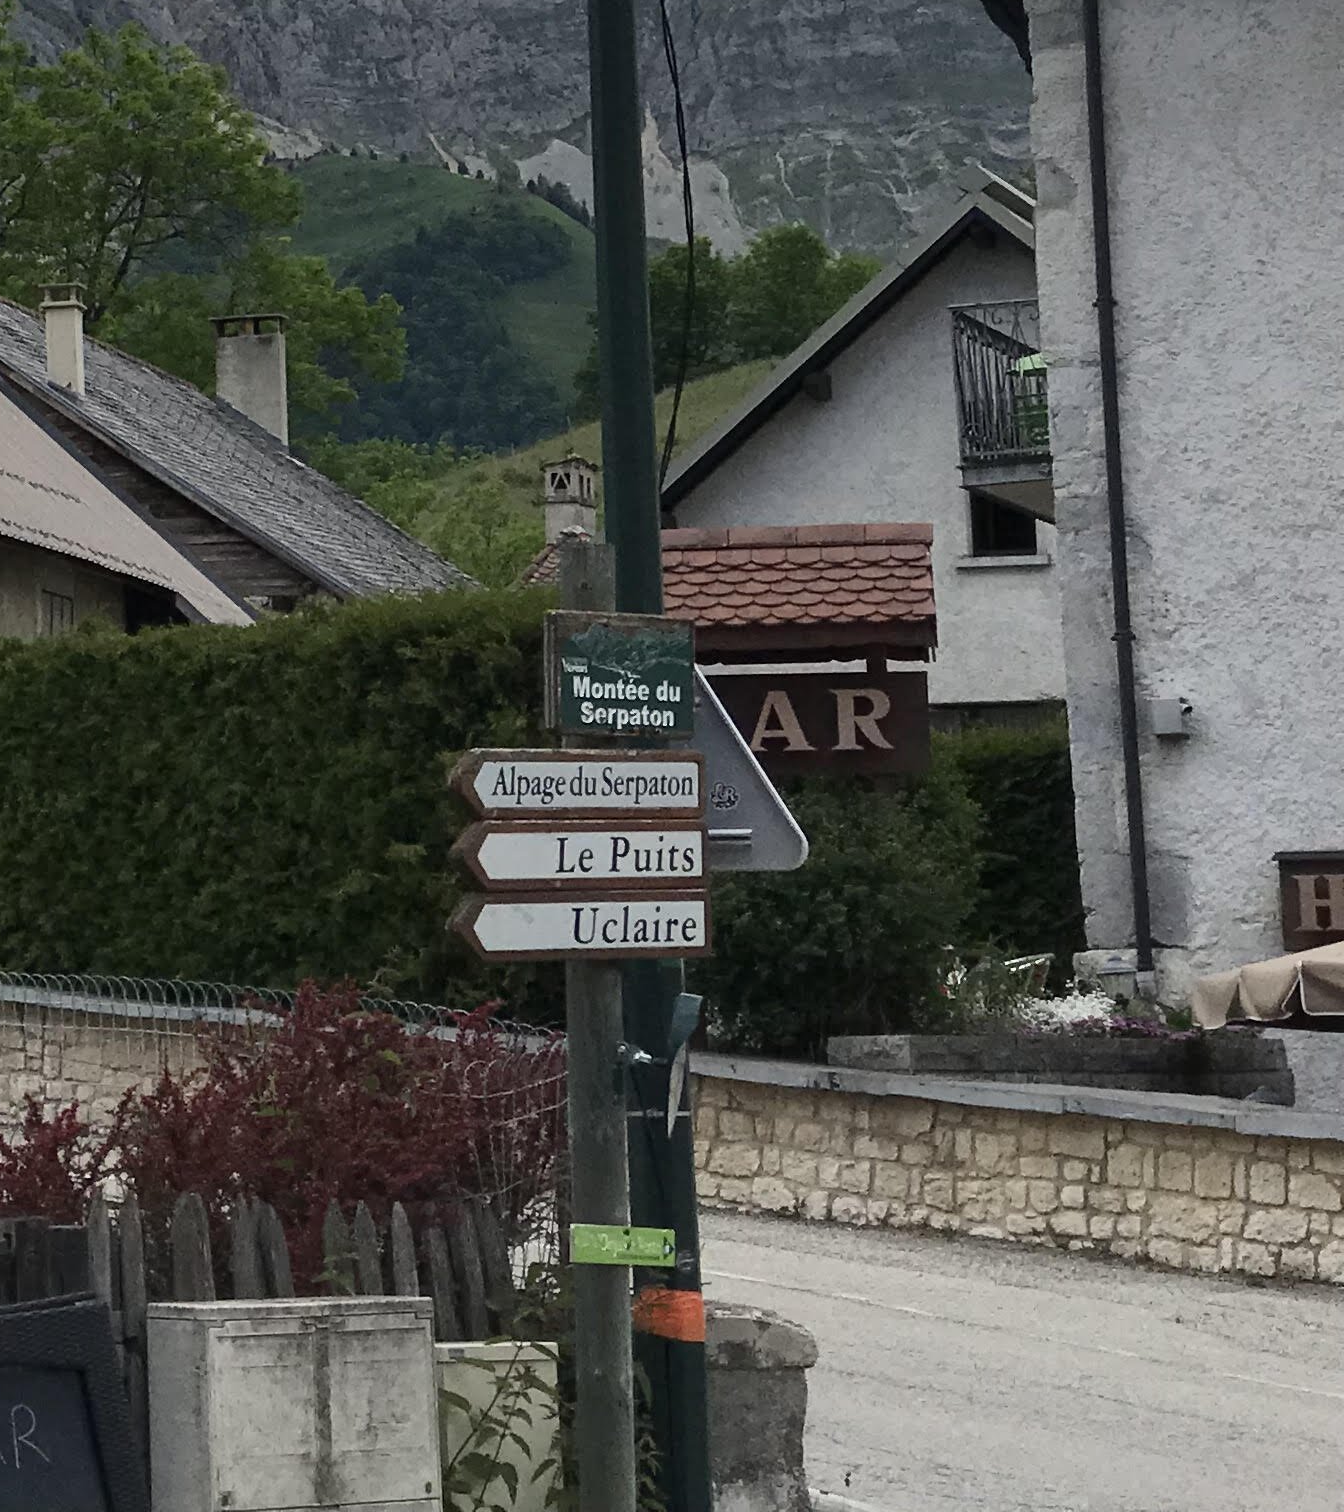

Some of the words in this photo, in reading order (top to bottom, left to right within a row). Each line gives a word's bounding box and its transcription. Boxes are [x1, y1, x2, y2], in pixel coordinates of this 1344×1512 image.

[573, 675, 650, 701] Montée
[656, 680, 681, 703] du
[580, 701, 675, 730] Serpaton
[491, 765, 566, 805] Alpage
[569, 765, 597, 797] du
[601, 766, 694, 805] Serpaton
[555, 837, 594, 874] Le
[609, 835, 695, 873] Puits
[571, 905, 697, 945] Uclaire
